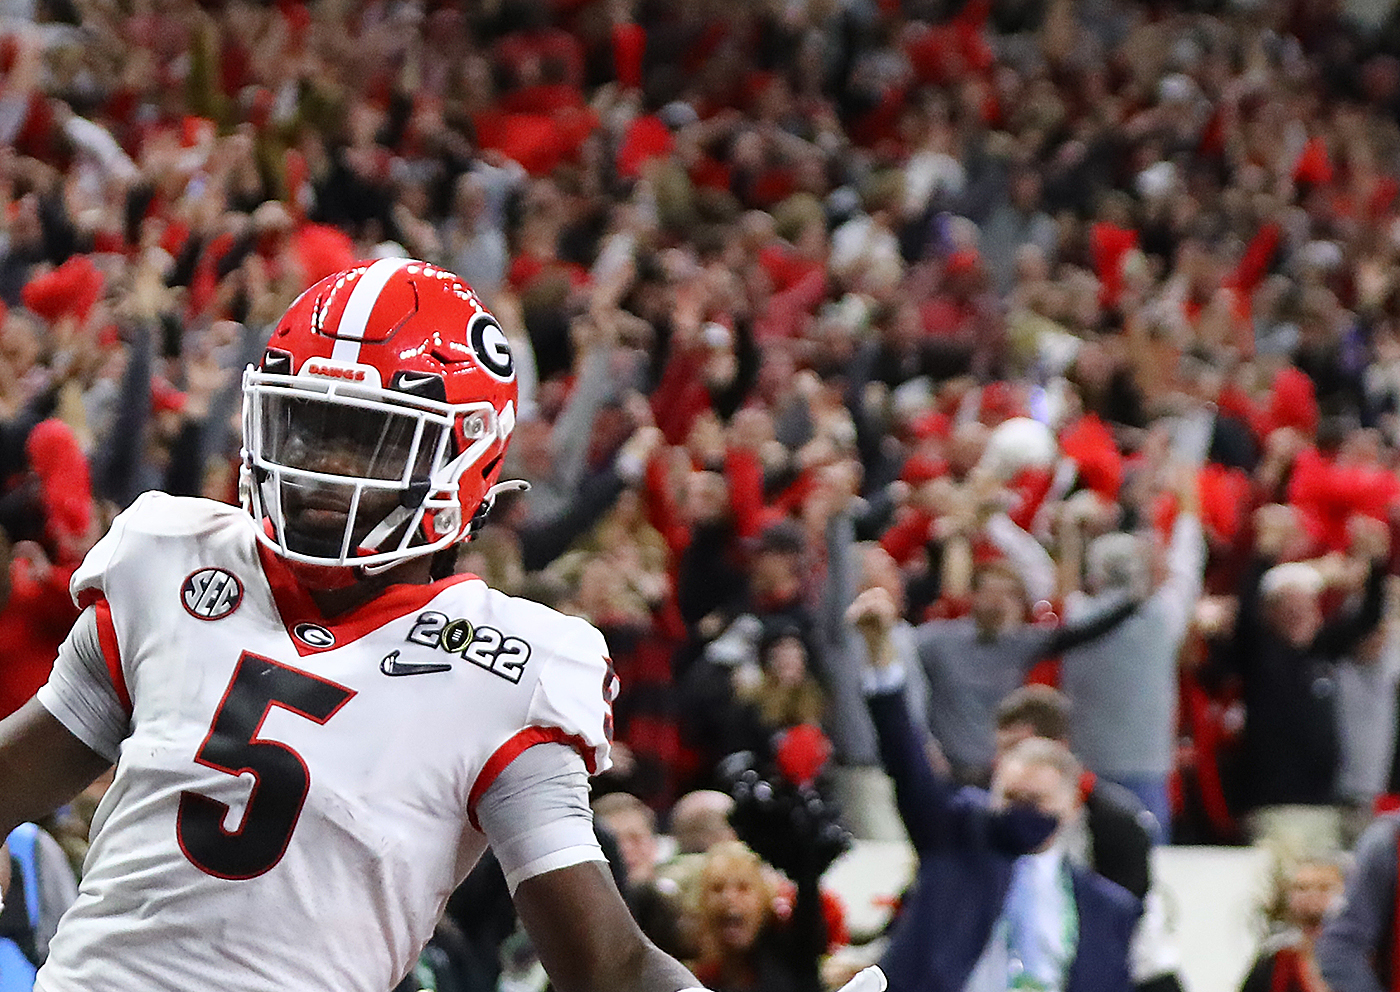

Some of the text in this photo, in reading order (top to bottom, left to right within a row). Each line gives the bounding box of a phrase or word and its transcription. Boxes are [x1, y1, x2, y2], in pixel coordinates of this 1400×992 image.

[308, 364, 366, 382] DAWGS
[185, 569, 238, 617] SEC
[405, 610, 532, 685] 2022
[176, 649, 359, 881] 5
